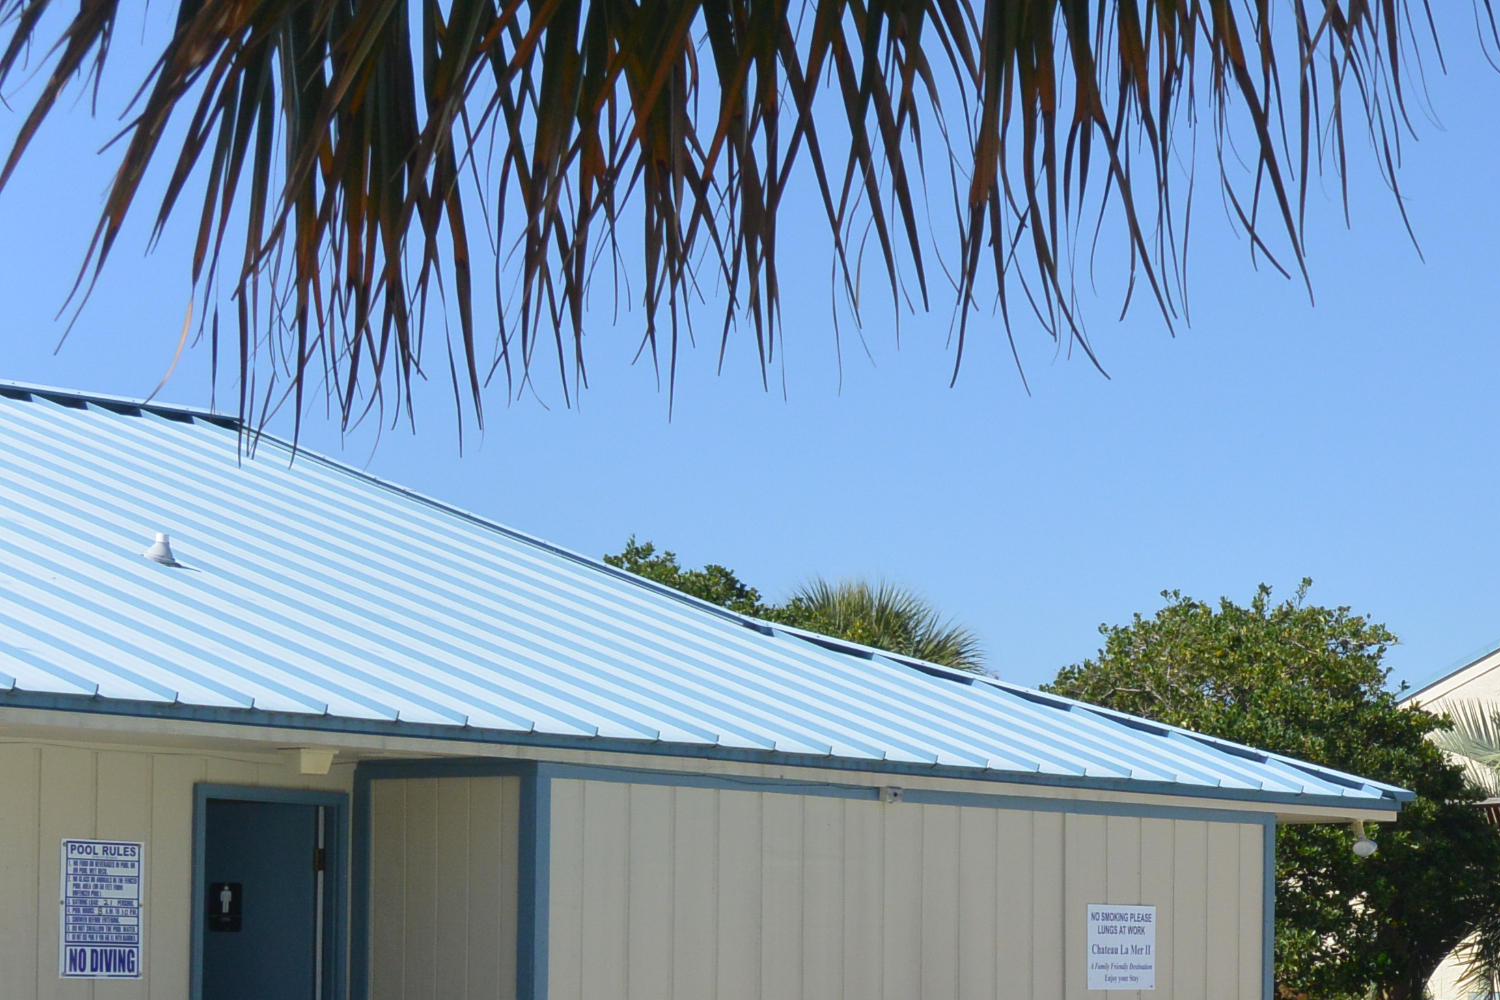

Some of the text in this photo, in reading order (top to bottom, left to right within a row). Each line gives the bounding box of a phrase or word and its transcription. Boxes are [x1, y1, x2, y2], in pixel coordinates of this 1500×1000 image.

[70, 844, 136, 857] POOL RULES
[1090, 912, 1152, 923] NO SMOKING PLEASE
[1097, 925, 1146, 935] LUNGS AT WORK
[1091, 943, 1119, 955] Chateau
[1120, 944, 1129, 955] La
[1130, 944, 1144, 955] Mer
[69, 948, 136, 974] NO DIVING
